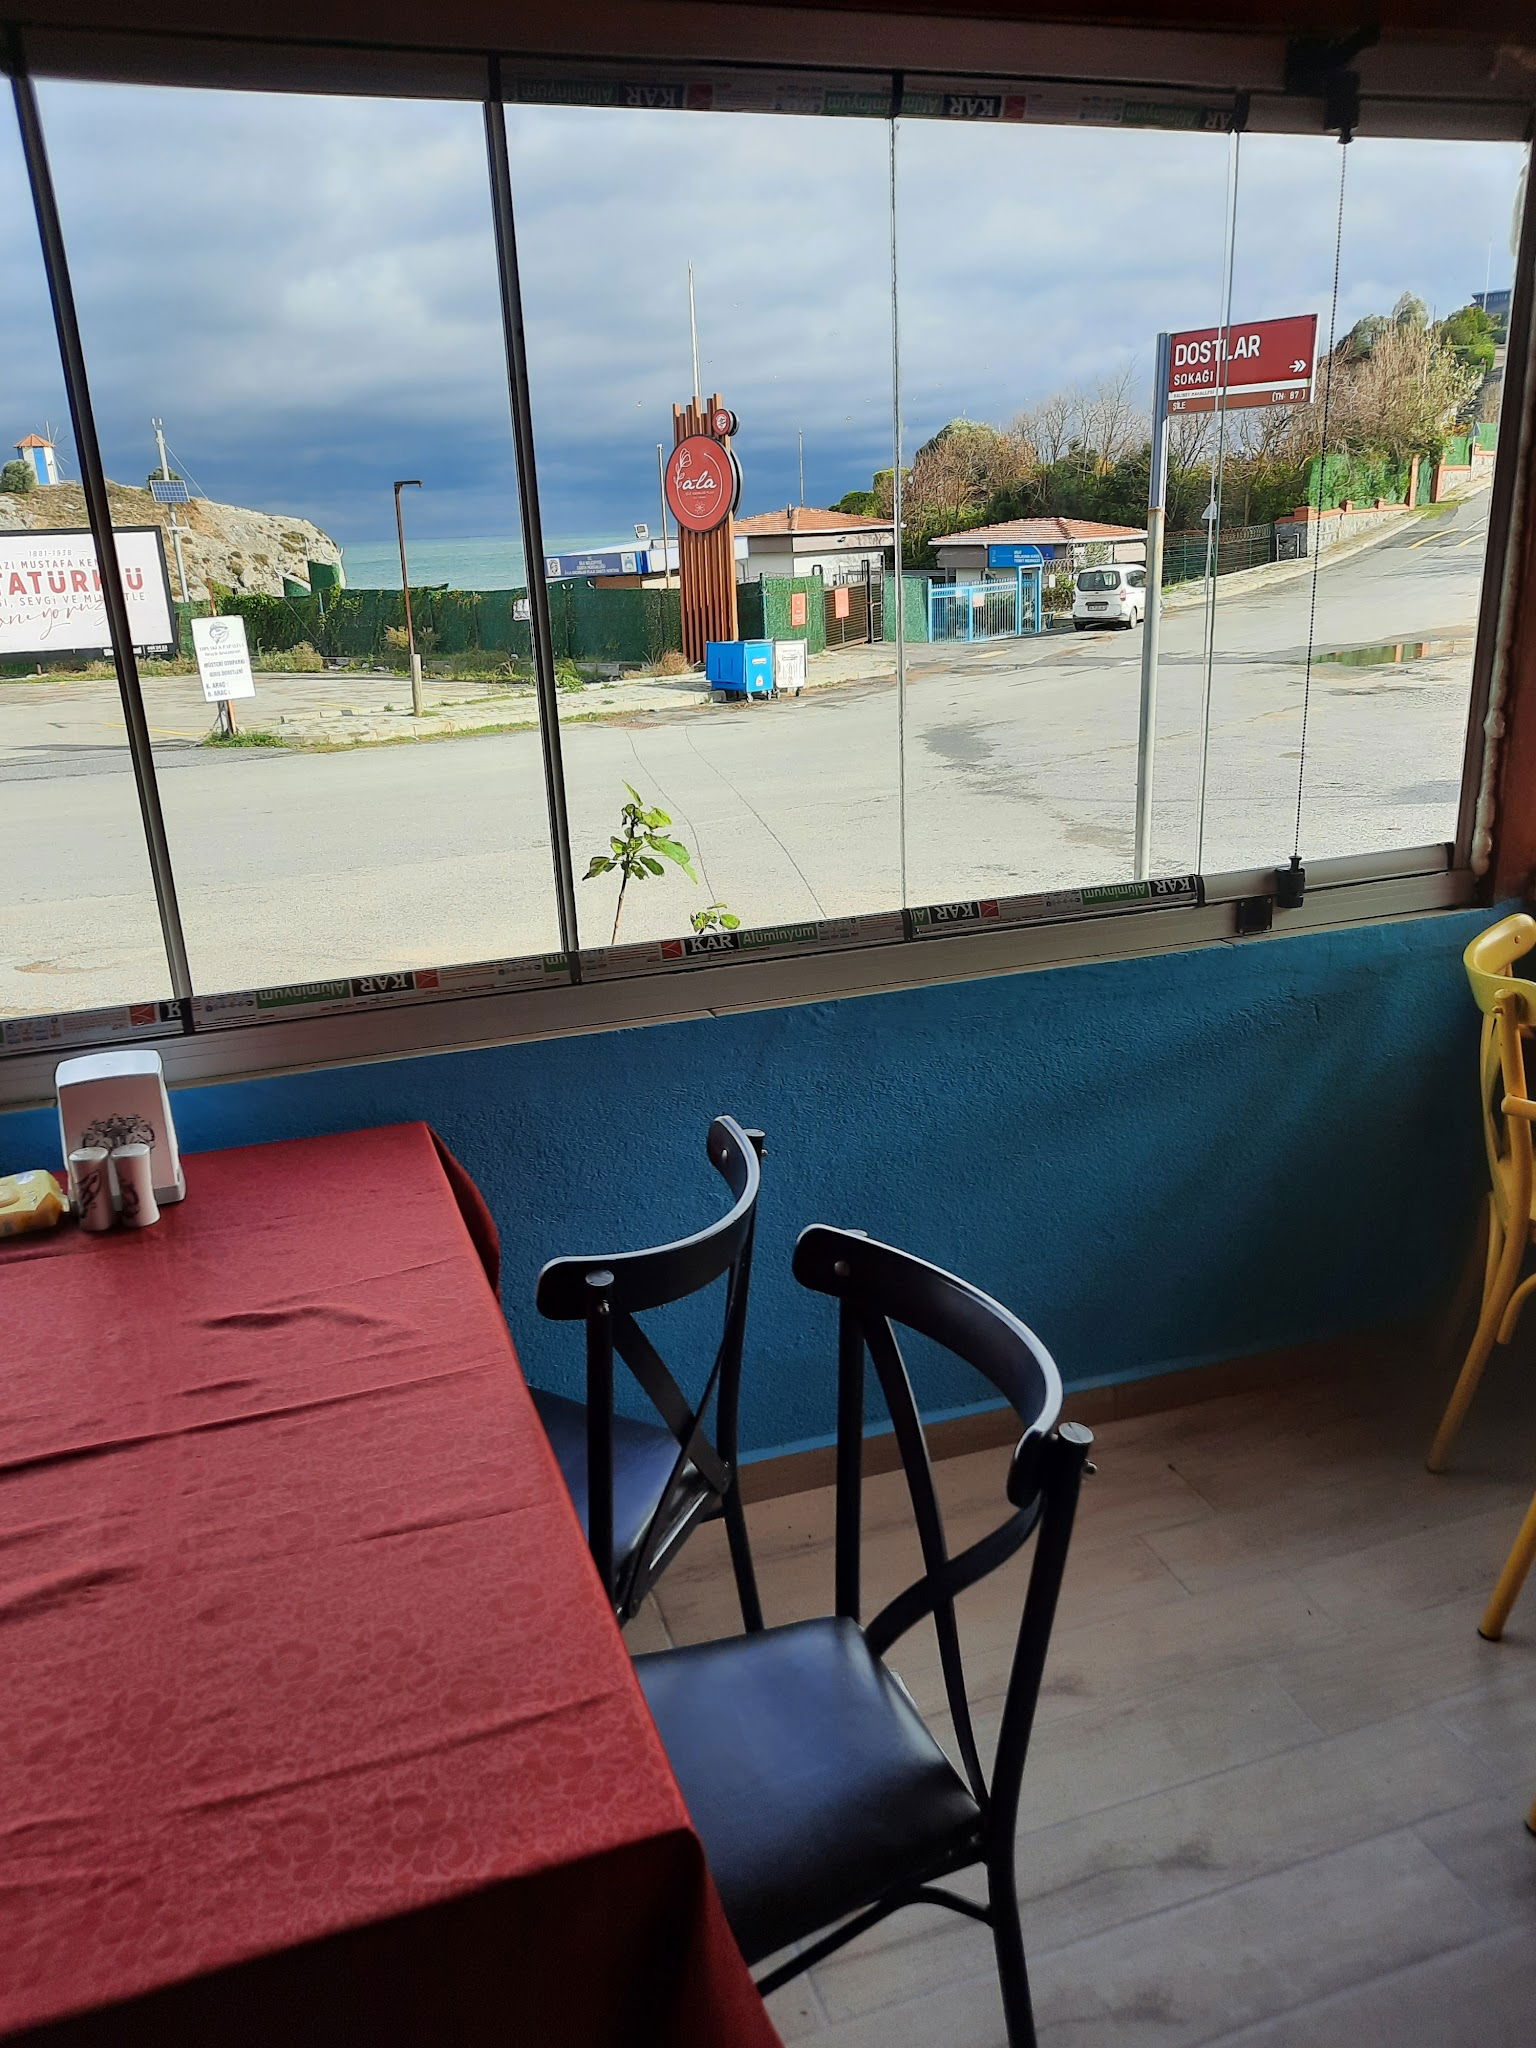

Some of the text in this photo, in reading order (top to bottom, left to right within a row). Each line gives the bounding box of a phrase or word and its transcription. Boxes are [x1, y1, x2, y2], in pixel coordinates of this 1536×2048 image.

[625, 85, 677, 107] KAR
[950, 97, 996, 118] KAR
[1175, 334, 1261, 366] DOSTLAR
[1173, 369, 1214, 386] SOKAĞI
[20, 559, 74, 569] MUSTAFA
[62, 595, 77, 604] VE
[1154, 877, 1192, 894] KAR
[934, 903, 975, 921] KAR
[690, 934, 735, 953] KAR
[743, 925, 816, 945] Alüminyum
[357, 971, 408, 992] KAR
